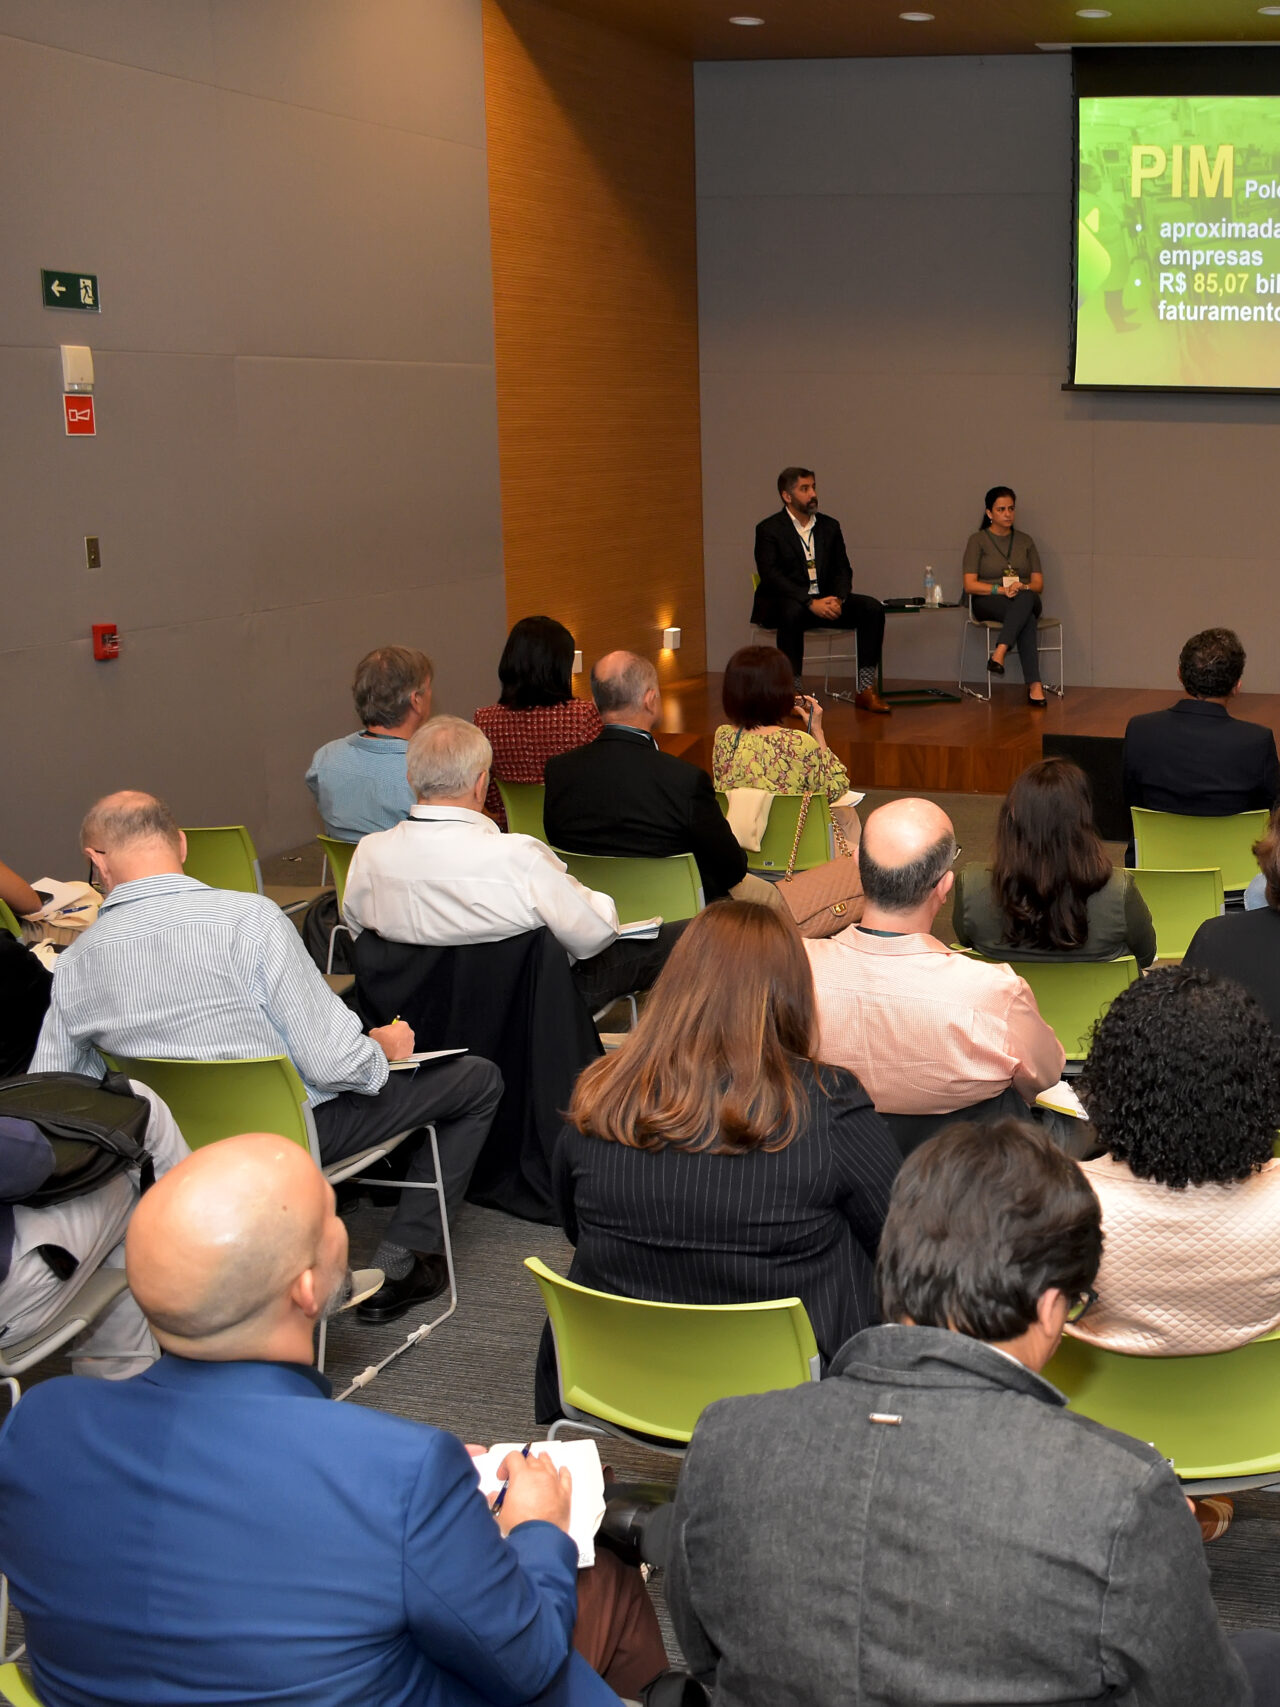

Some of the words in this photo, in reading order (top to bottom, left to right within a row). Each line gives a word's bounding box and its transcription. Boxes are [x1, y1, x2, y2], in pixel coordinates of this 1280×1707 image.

[1131, 144, 1234, 198] PIM
[1159, 249, 1263, 270] empresas
[1159, 271, 1187, 294] R$
[1193, 272, 1249, 297] 85,07
